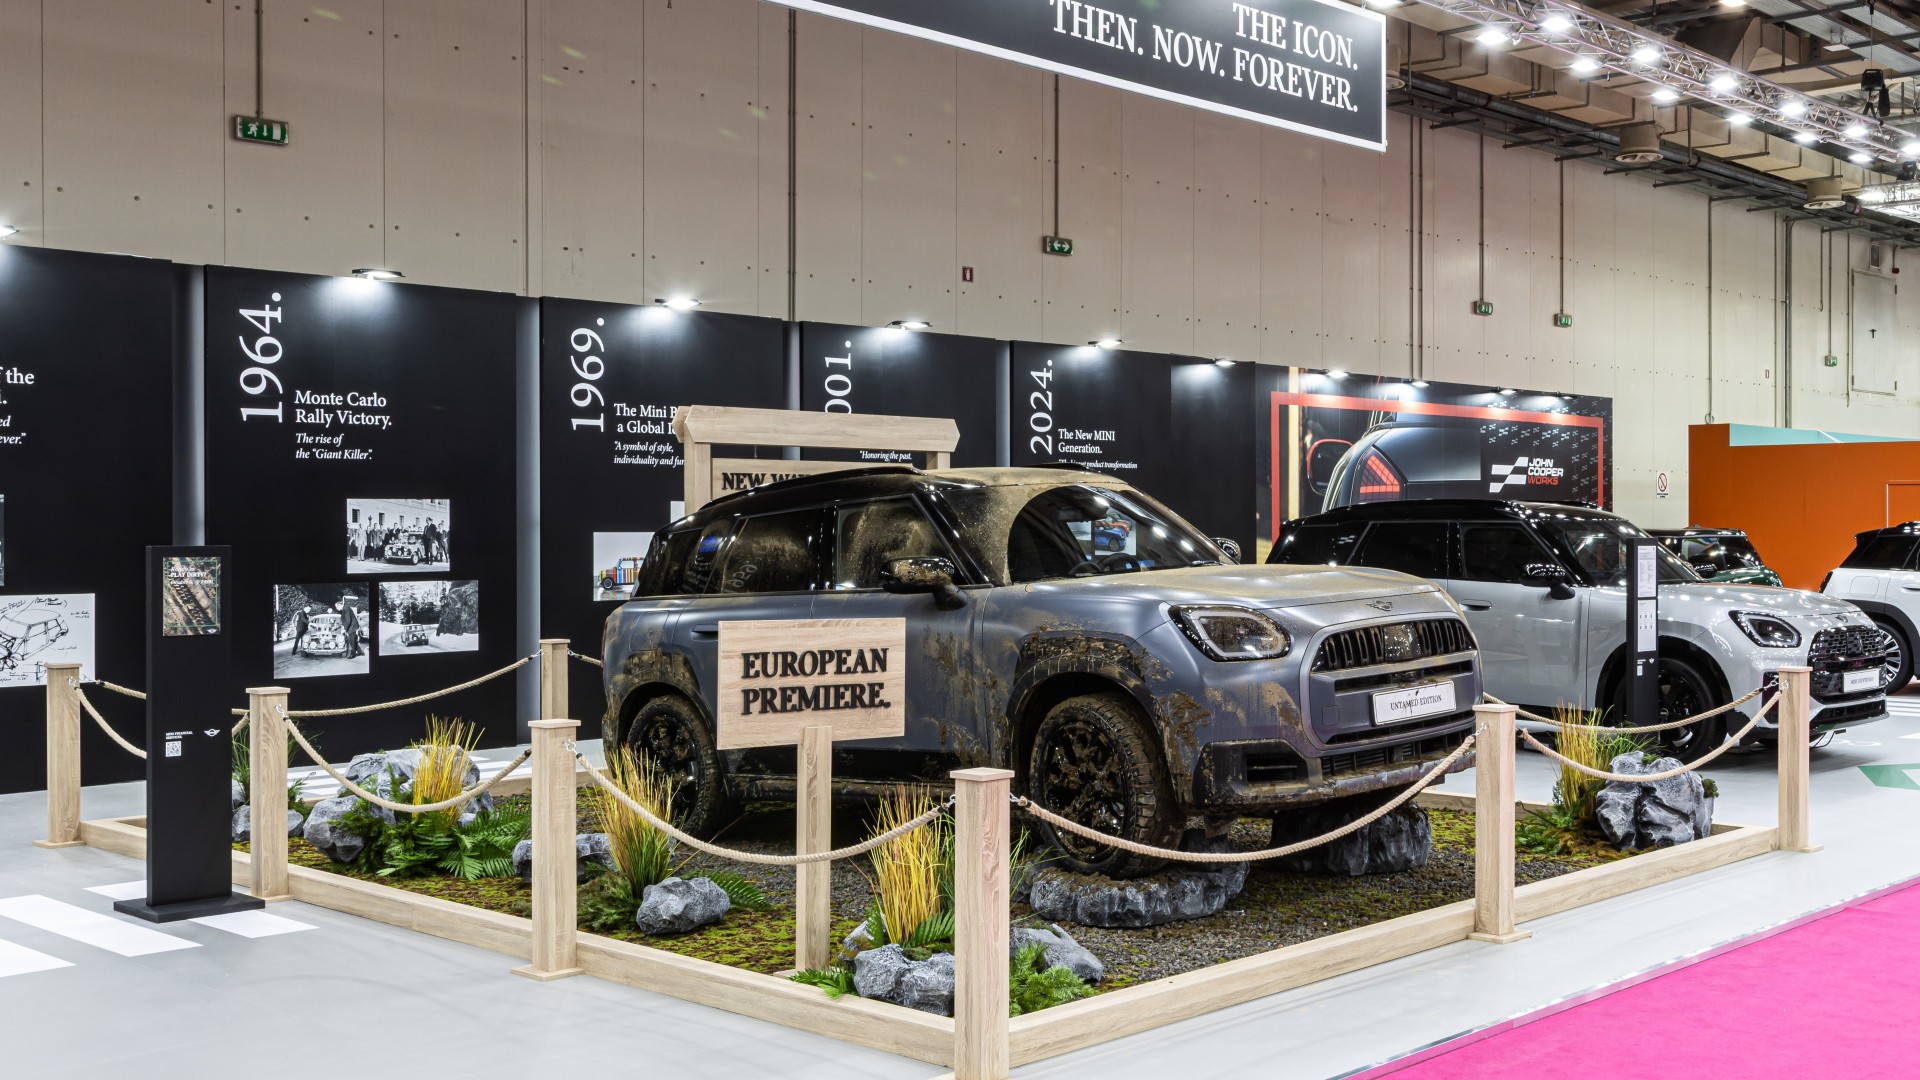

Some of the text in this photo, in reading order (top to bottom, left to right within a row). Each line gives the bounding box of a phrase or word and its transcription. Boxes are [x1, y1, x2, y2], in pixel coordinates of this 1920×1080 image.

[1233, 2, 1359, 71] THE ICON.
[1049, 0, 1359, 112] THEN. NOW. FOREVER.
[238, 292, 283, 423] 1964.
[5, 367, 35, 385] the
[570, 317, 605, 432] 1969.
[294, 390, 387, 407] Monte Carlo
[614, 403, 637, 417] The
[640, 404, 667, 418] Mini
[1030, 359, 1053, 455] 2024.
[295, 409, 392, 430] Rally Victory.
[617, 423, 624, 433] a
[626, 420, 665, 434] Global
[296, 432, 344, 447] The rise of
[1058, 428, 1115, 441] The New MINI
[296, 448, 310, 459] the
[622, 441, 648, 454] symbol
[648, 442, 658, 455] of
[657, 443, 674, 455] style,
[890, 450, 899, 459] the
[1058, 442, 1103, 454] Generation.
[613, 455, 659, 467] individuality
[660, 456, 674, 466] and
[1528, 457, 1554, 468] JOHN
[1527, 466, 1564, 477] COOPER
[722, 472, 767, 490] NEW
[1527, 476, 1559, 486] WORKS
[741, 648, 889, 679] EUROPEAN
[741, 682, 892, 715] PREMIERE.
[1390, 694, 1442, 711] UNTAMED EDITION
